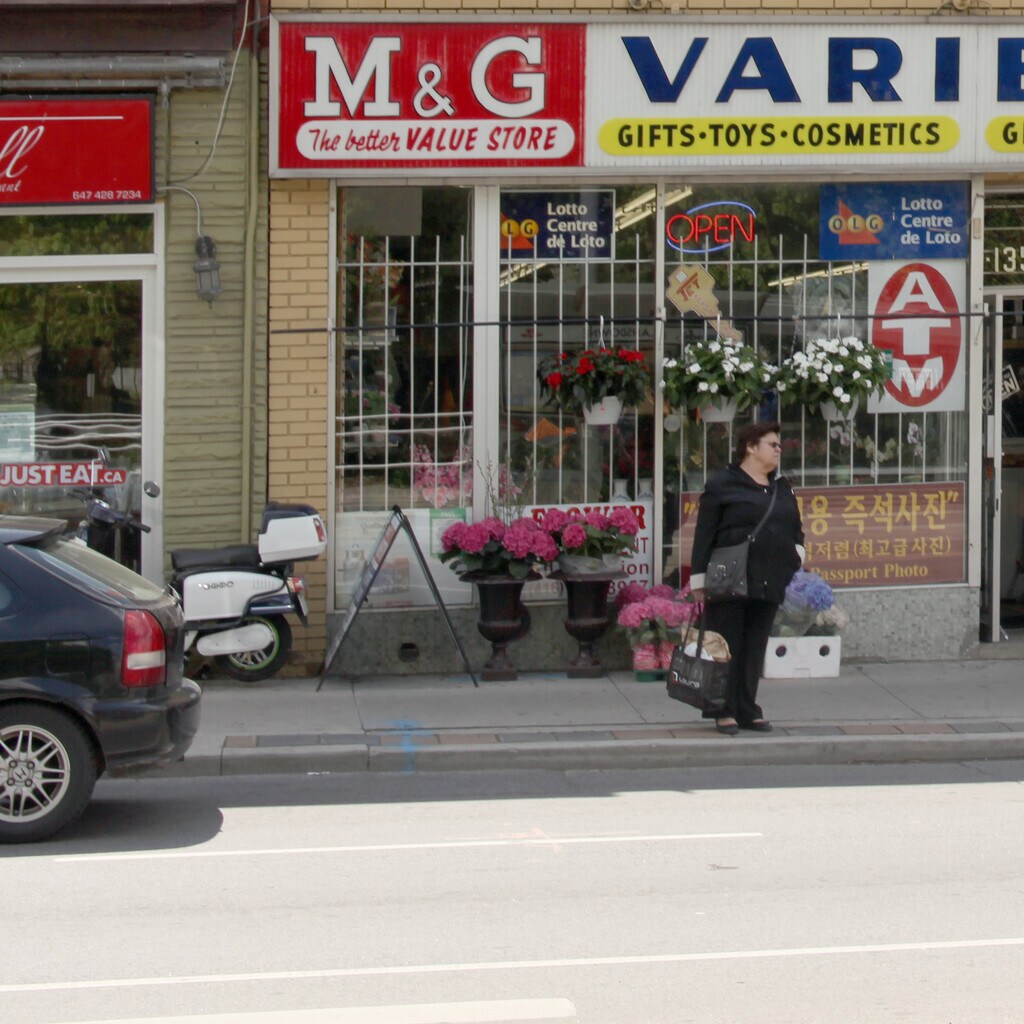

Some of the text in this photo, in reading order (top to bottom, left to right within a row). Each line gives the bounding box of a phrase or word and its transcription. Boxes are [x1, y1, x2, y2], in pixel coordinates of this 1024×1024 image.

[304, 35, 546, 118] M & G
[308, 125, 557, 152] The better VALUE STORE
[72, 190, 92, 200] 647
[547, 202, 588, 216] Lotto
[901, 197, 943, 211] Lotto
[547, 218, 598, 232] Centre
[830, 216, 882, 232] OLG
[900, 214, 953, 228] Centre
[666, 213, 755, 244] OPEN
[547, 234, 606, 249] de Loto
[900, 231, 961, 245] de Loto
[1, 464, 58, 485] JUST
[884, 563, 928, 577] Photo
